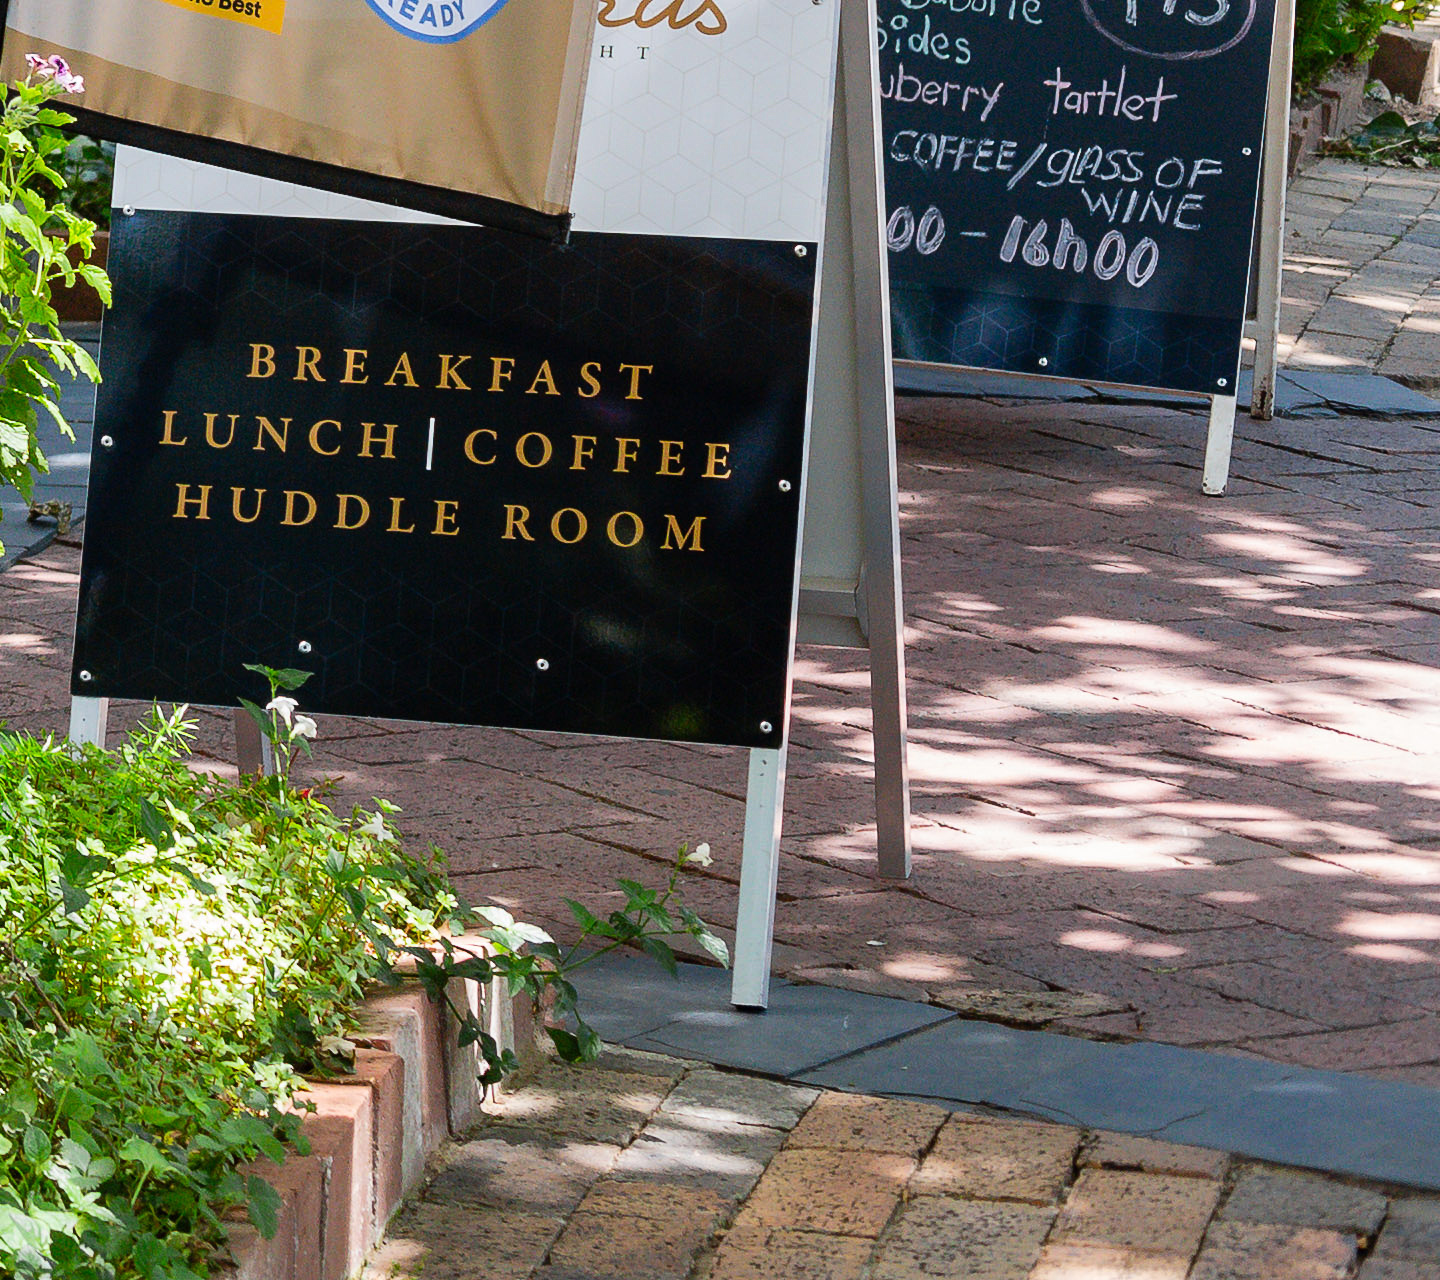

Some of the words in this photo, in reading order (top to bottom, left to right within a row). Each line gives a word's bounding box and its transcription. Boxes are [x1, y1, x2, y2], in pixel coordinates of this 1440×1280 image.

[1081, 188, 1206, 231] WINE
[248, 344, 653, 399] BREAKFAST
[160, 411, 397, 458] LUNCH
[464, 429, 730, 478] COFFEE
[173, 484, 459, 535] HUDDLE
[502, 505, 707, 551] ROOM
